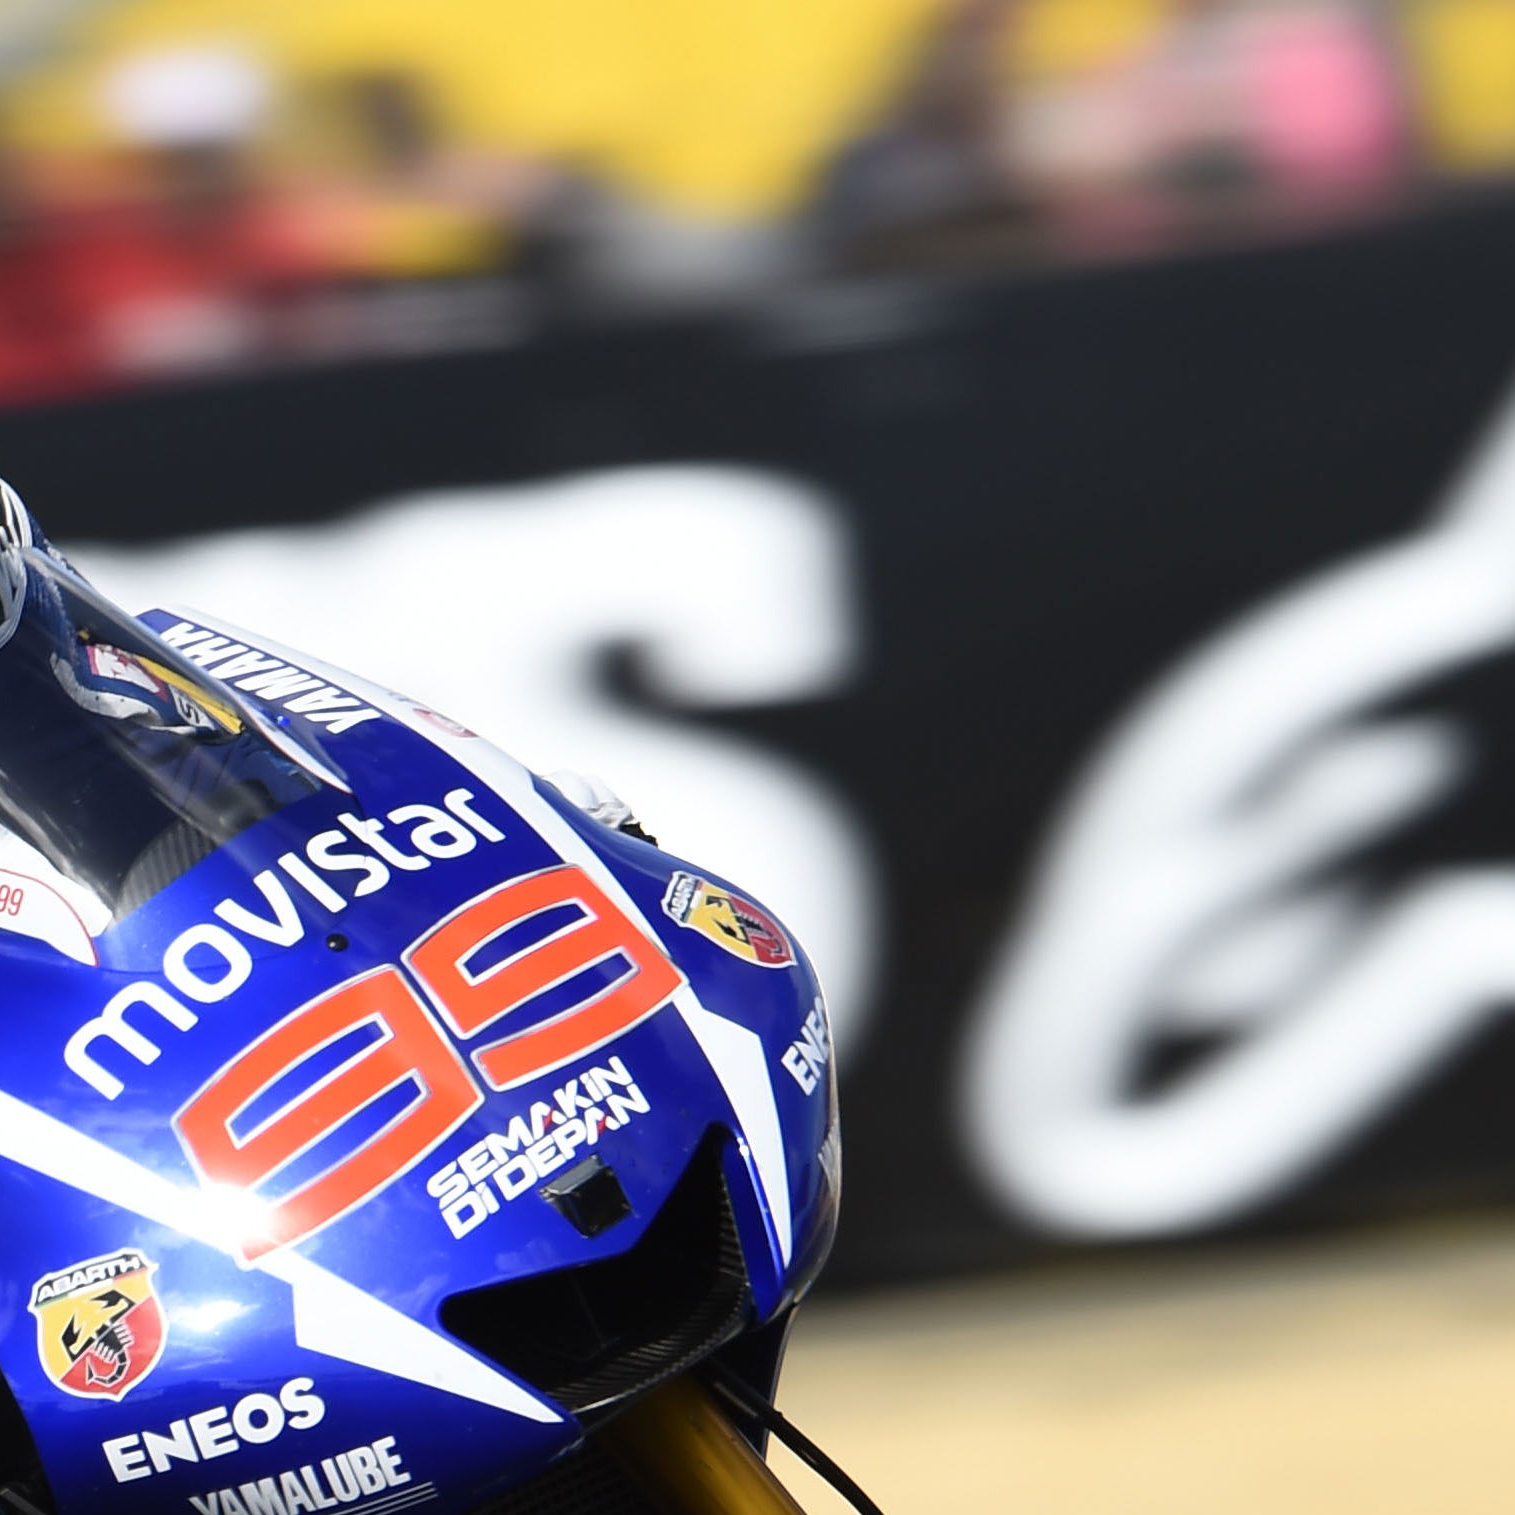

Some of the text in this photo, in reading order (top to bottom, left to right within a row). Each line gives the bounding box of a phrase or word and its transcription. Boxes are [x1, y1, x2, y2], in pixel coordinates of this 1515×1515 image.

[158, 620, 382, 735] YAMAHA
[64, 787, 506, 1102] movistar
[170, 863, 691, 1269] 99
[781, 995, 832, 1096] ENE
[492, 1083, 651, 1202] DEPAN
[36, 1255, 141, 1303] ABARTH
[101, 1376, 326, 1484] ENEOS
